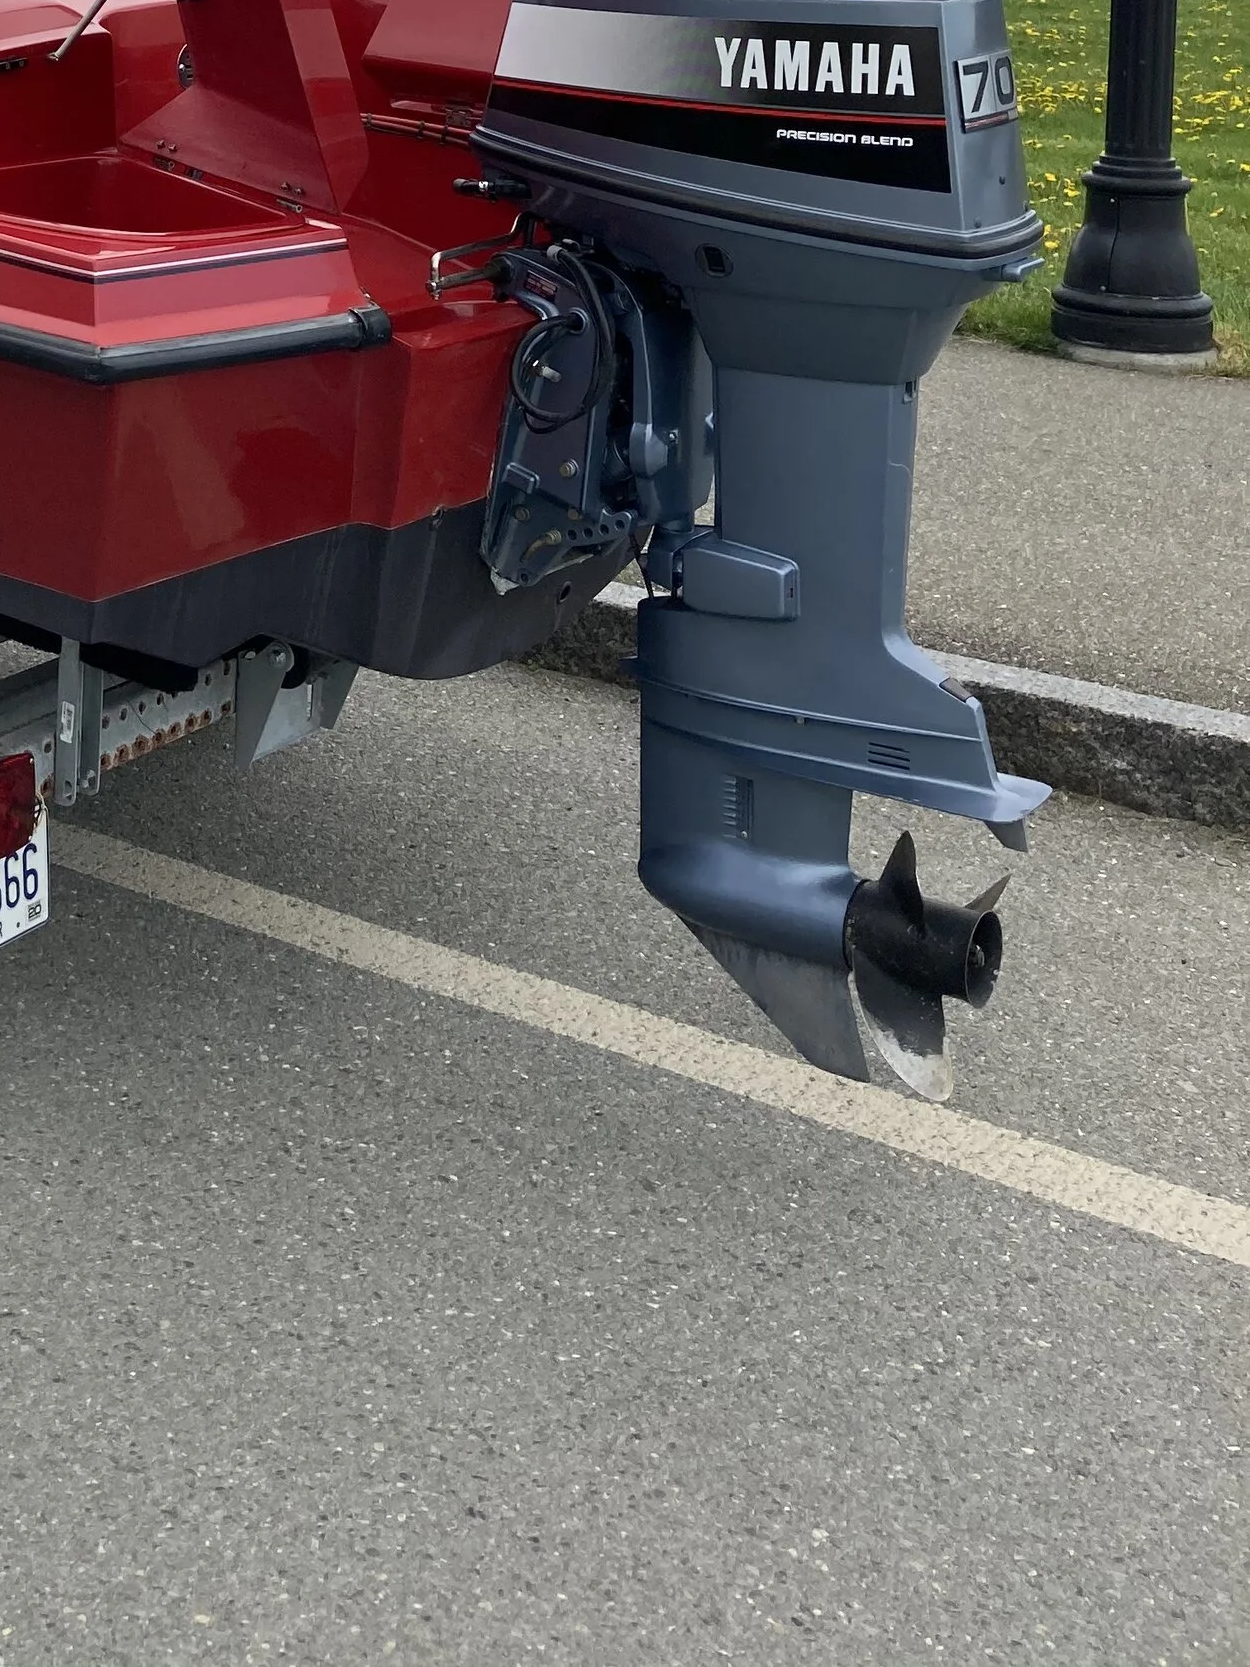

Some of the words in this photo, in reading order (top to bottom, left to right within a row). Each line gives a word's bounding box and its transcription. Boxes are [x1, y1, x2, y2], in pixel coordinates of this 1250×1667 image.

[715, 36, 916, 97] YAMAHA
[962, 56, 1015, 113] 70
[776, 128, 857, 144] PRECISION
[860, 134, 914, 147] BLEND
